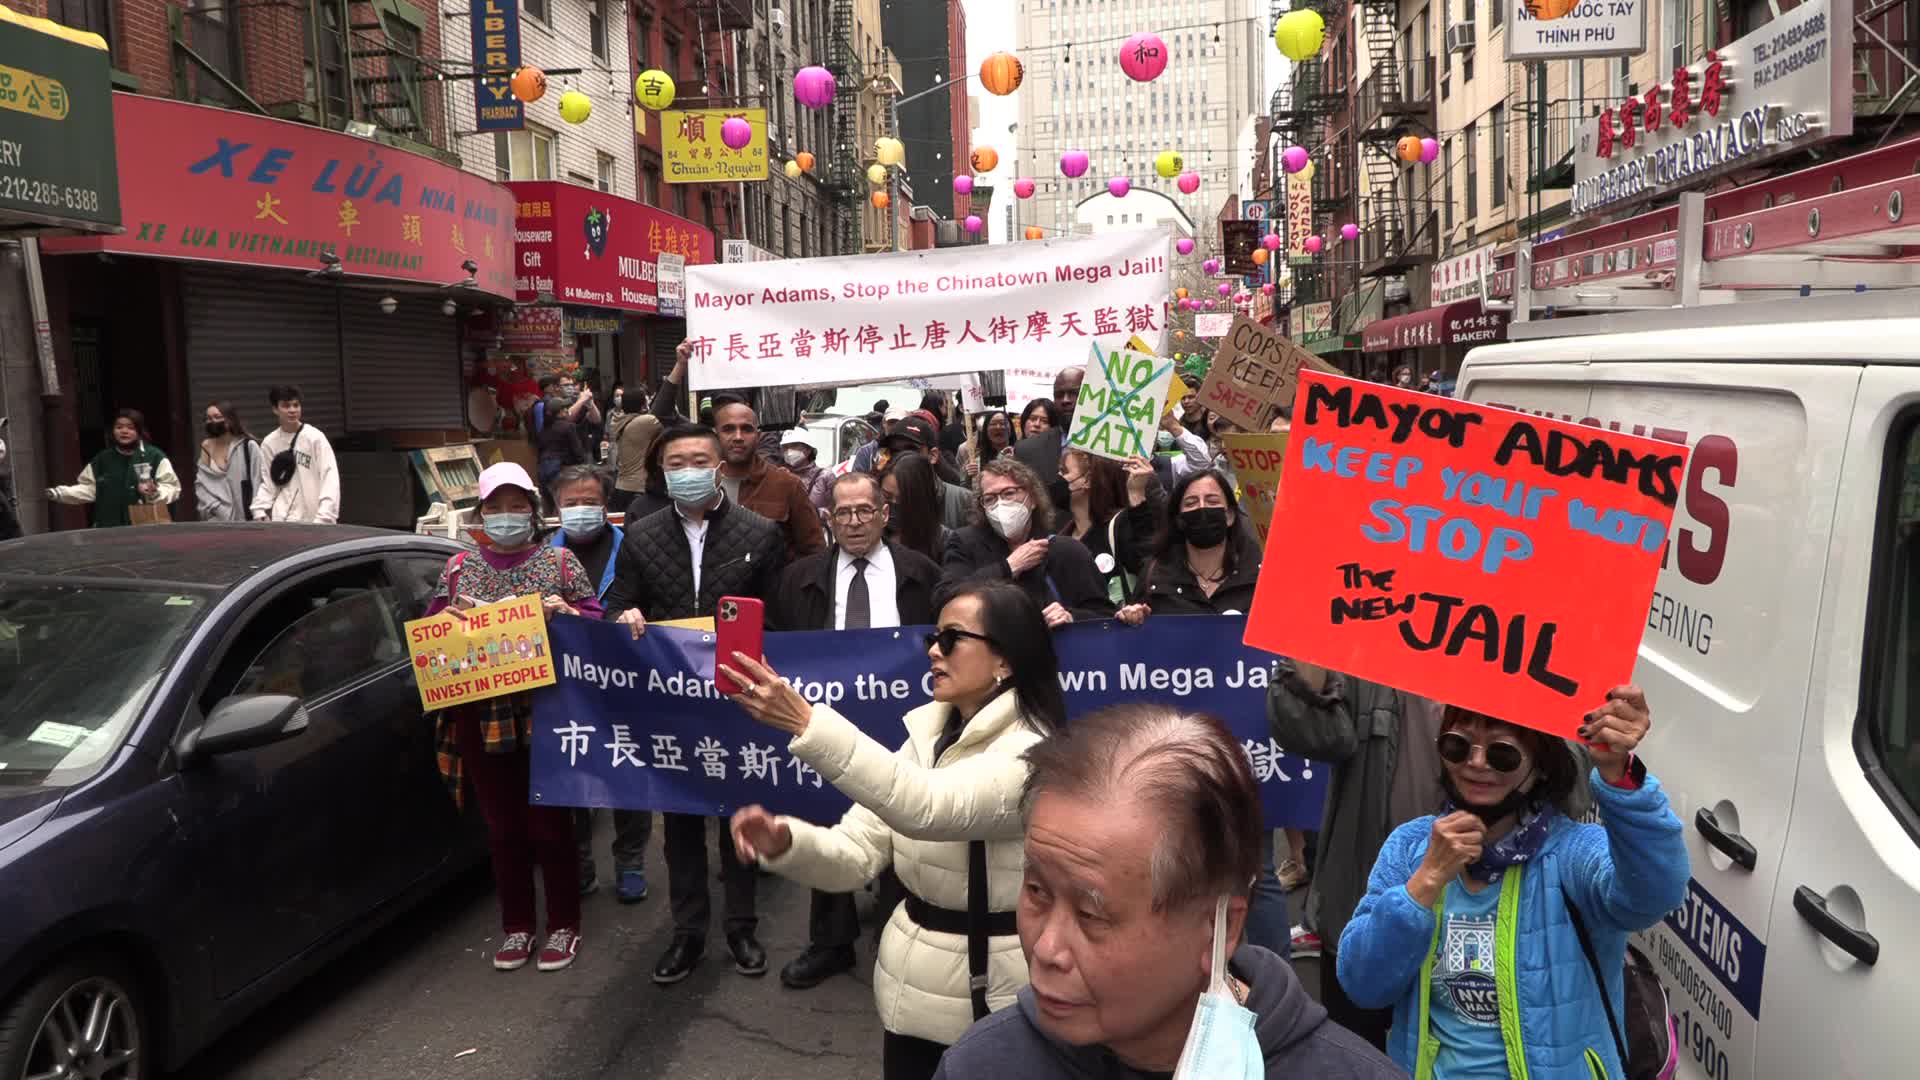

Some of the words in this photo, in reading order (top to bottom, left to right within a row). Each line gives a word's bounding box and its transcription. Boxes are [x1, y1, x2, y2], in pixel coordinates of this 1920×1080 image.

[1134, 40, 1160, 65] 和
[642, 77, 665, 97] 吉
[0, 140, 22, 167] RY
[187, 137, 295, 185] XE
[1569, 152, 1650, 216] MULBERRY
[1654, 103, 1772, 186] PHARMACY
[136, 223, 168, 243] XE
[181, 226, 219, 248] LUA
[522, 251, 541, 268] Gift
[565, 287, 575, 297] 84
[575, 289, 605, 304] Mulberry
[695, 291, 754, 311] Mayor
[762, 287, 835, 304] Adams,
[843, 279, 889, 299] Stop
[897, 278, 929, 294] the
[936, 269, 1047, 292] Chinatown
[1056, 264, 1112, 284] Mega
[1119, 255, 1163, 277] Jail!
[1233, 323, 1285, 364] COPS
[1452, 330, 1497, 343] BAKERY
[1105, 350, 1155, 389] NO
[1226, 355, 1285, 394] KEEP
[1078, 382, 1156, 425] MEGA
[1071, 415, 1145, 457] JAIL
[1231, 448, 1282, 473] STOP
[1302, 437, 1424, 489] KEEP
[1494, 421, 1683, 508] ADAMS
[1360, 499, 1534, 574] STOP
[412, 622, 452, 643] STOP
[459, 612, 491, 634] THE
[497, 604, 537, 624] JAIL
[1398, 592, 1581, 697] JAIL
[425, 681, 471, 703] INVEST
[475, 677, 490, 692] IN
[493, 663, 549, 689] PEOPLE
[563, 653, 638, 690] Mayor
[855, 673, 910, 700] the
[1119, 663, 1215, 696] Mega
[1225, 660, 1278, 689] Jai
[1670, 889, 1742, 983] STEMS
[1457, 988, 1497, 1004] NYC
[1658, 933, 1733, 1041] 19HC00627400
